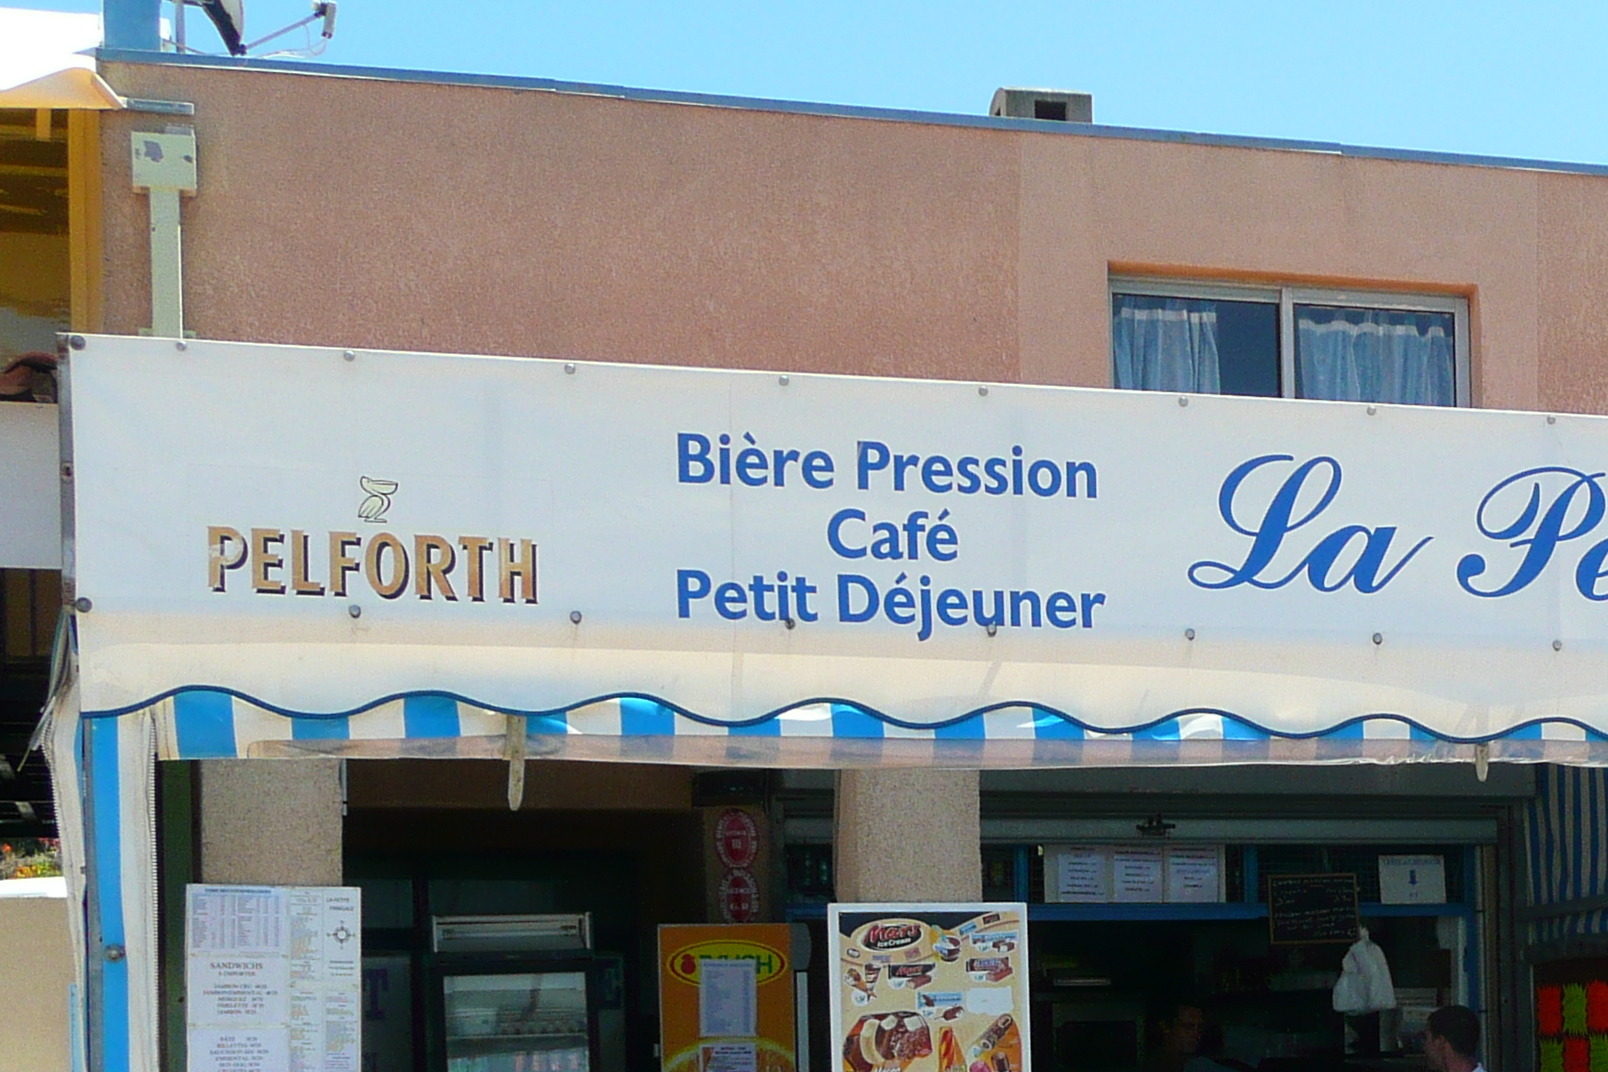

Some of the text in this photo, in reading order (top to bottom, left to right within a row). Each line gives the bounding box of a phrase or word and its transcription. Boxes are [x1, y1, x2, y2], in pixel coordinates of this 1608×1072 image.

[676, 432, 1099, 500] Bière Pression
[826, 507, 960, 563] Café
[1188, 454, 1434, 594] La
[207, 525, 539, 606] PELFORTH
[676, 569, 1106, 641] Petit Déjeuner
[210, 962, 264, 970] SANDWICHS
[864, 924, 921, 944] Mars
